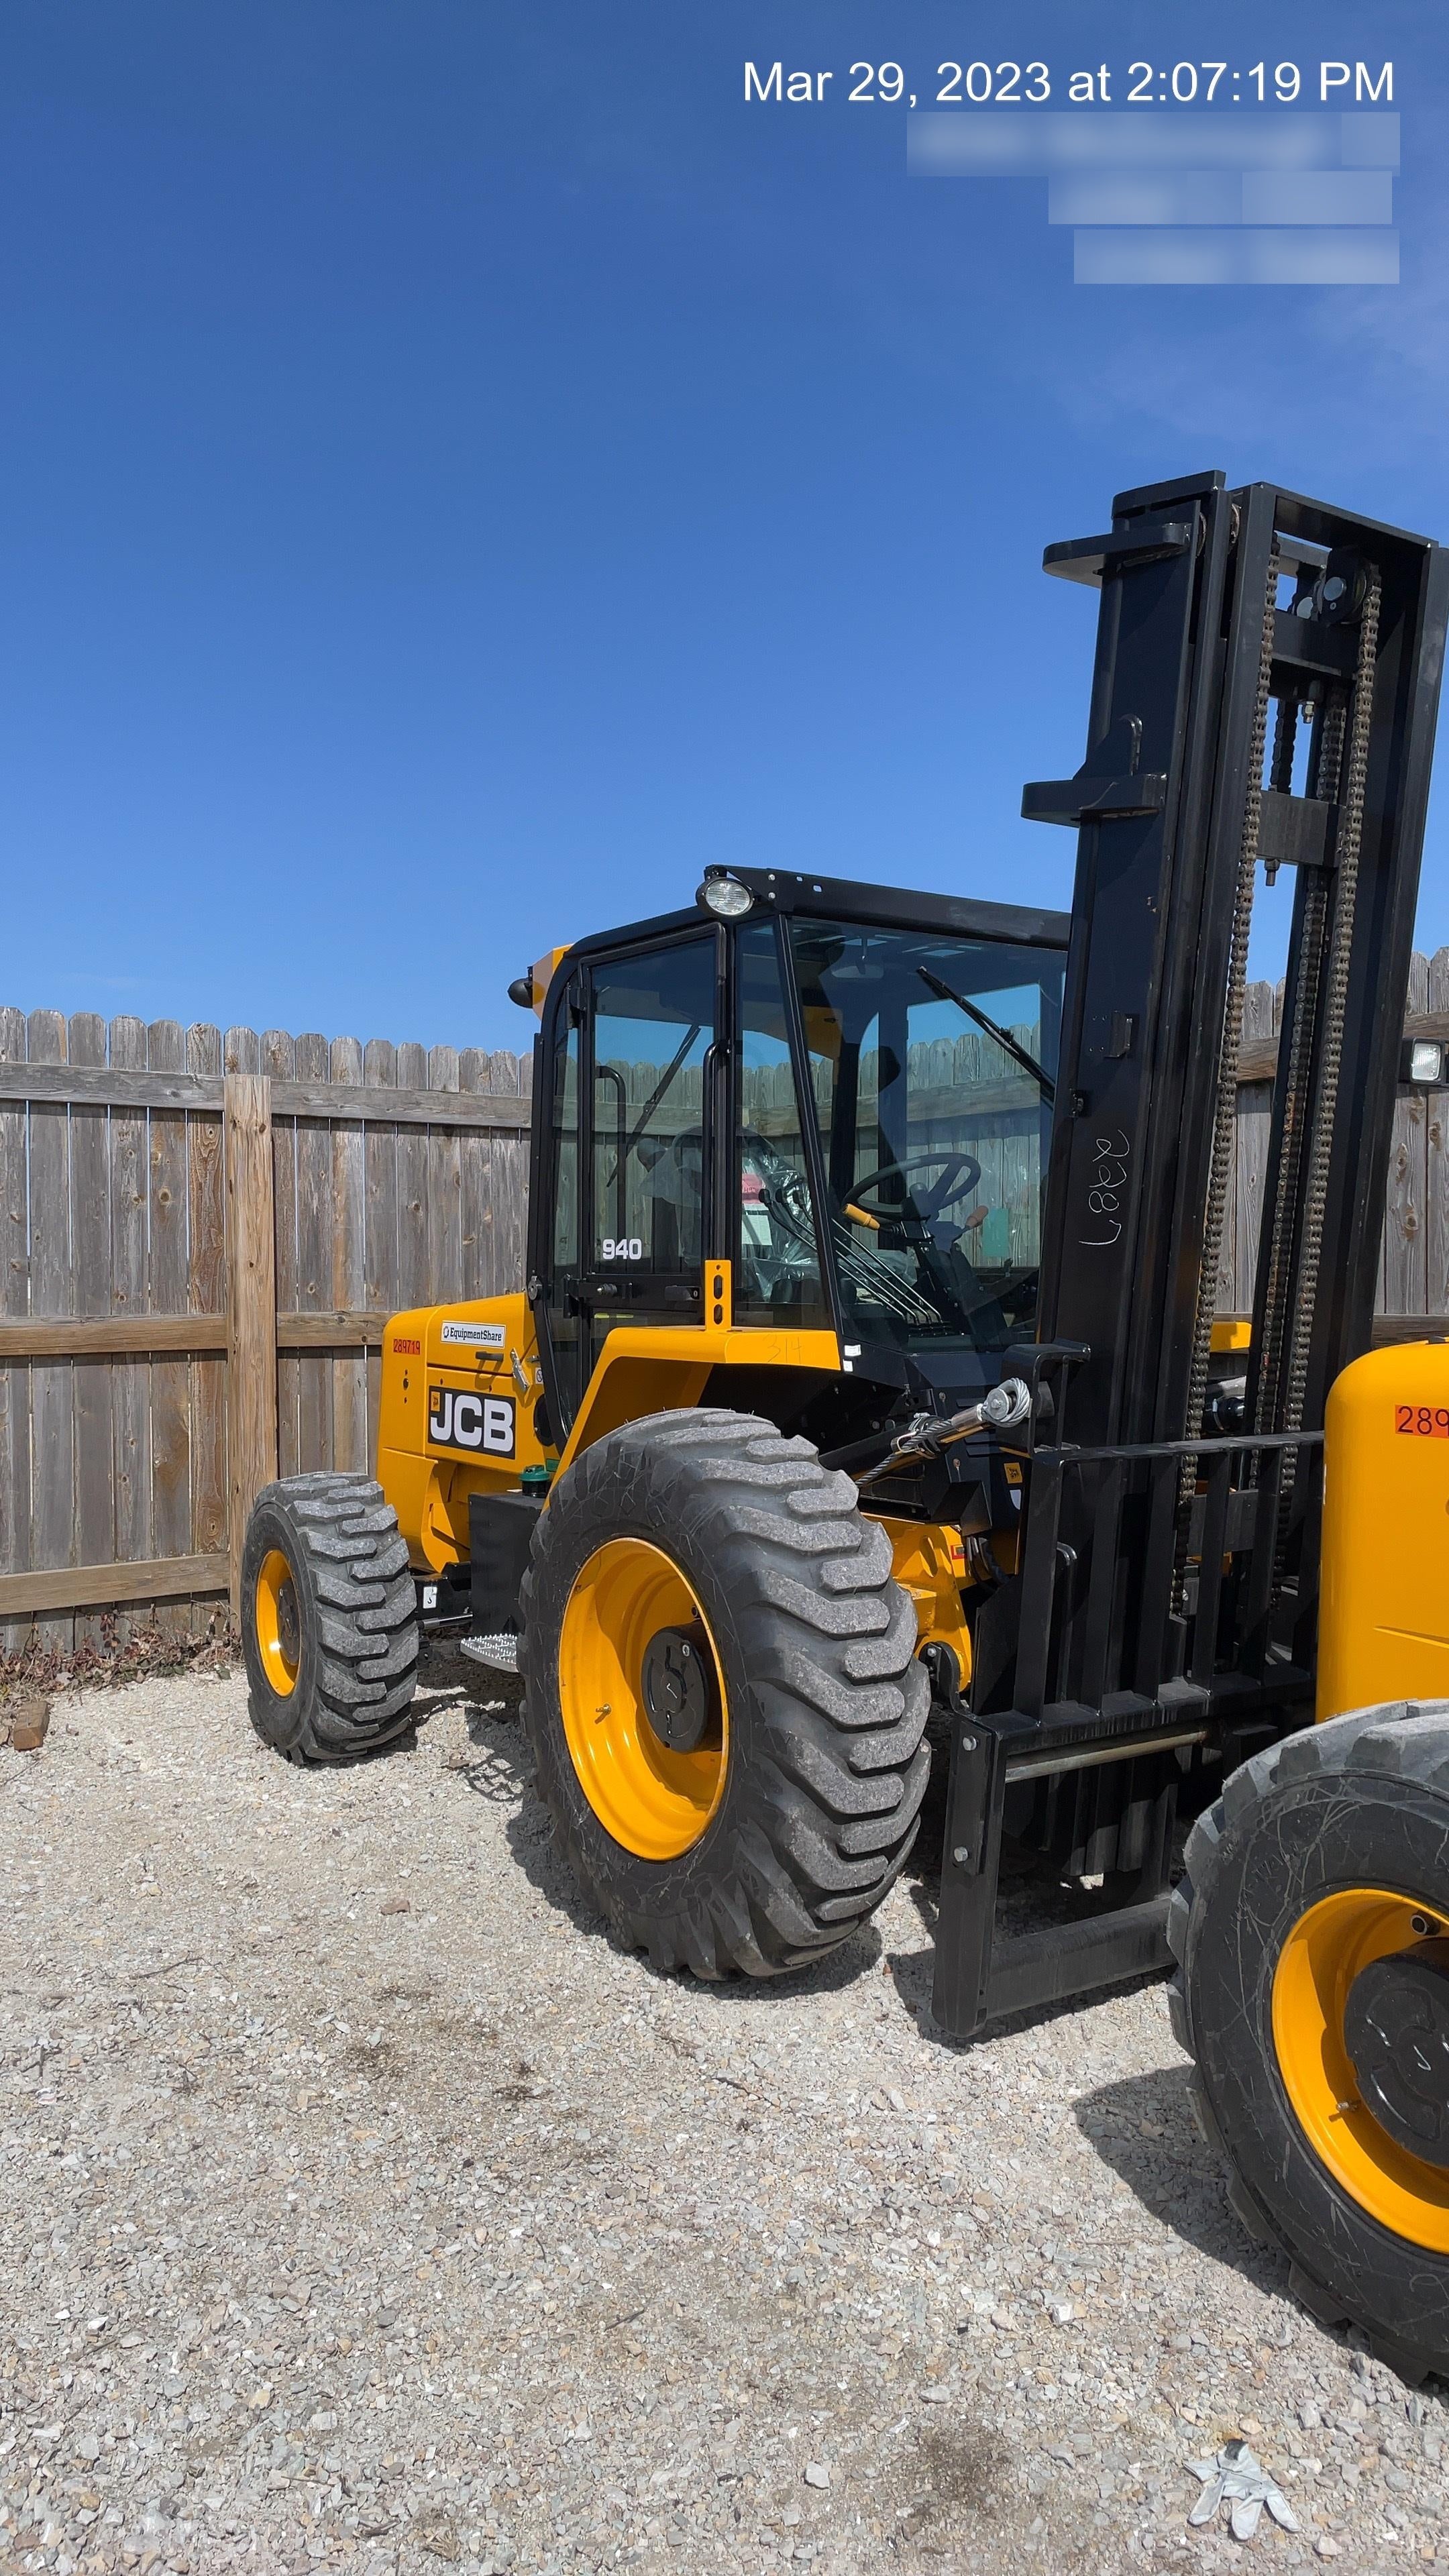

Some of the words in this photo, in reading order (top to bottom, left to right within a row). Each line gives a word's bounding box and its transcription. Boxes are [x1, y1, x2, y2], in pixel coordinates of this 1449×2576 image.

[602, 1238, 642, 1260] 940
[450, 1327, 502, 1341] EquipmentShare
[393, 1338, 421, 1355] 289719
[430, 1391, 514, 1452] JCB
